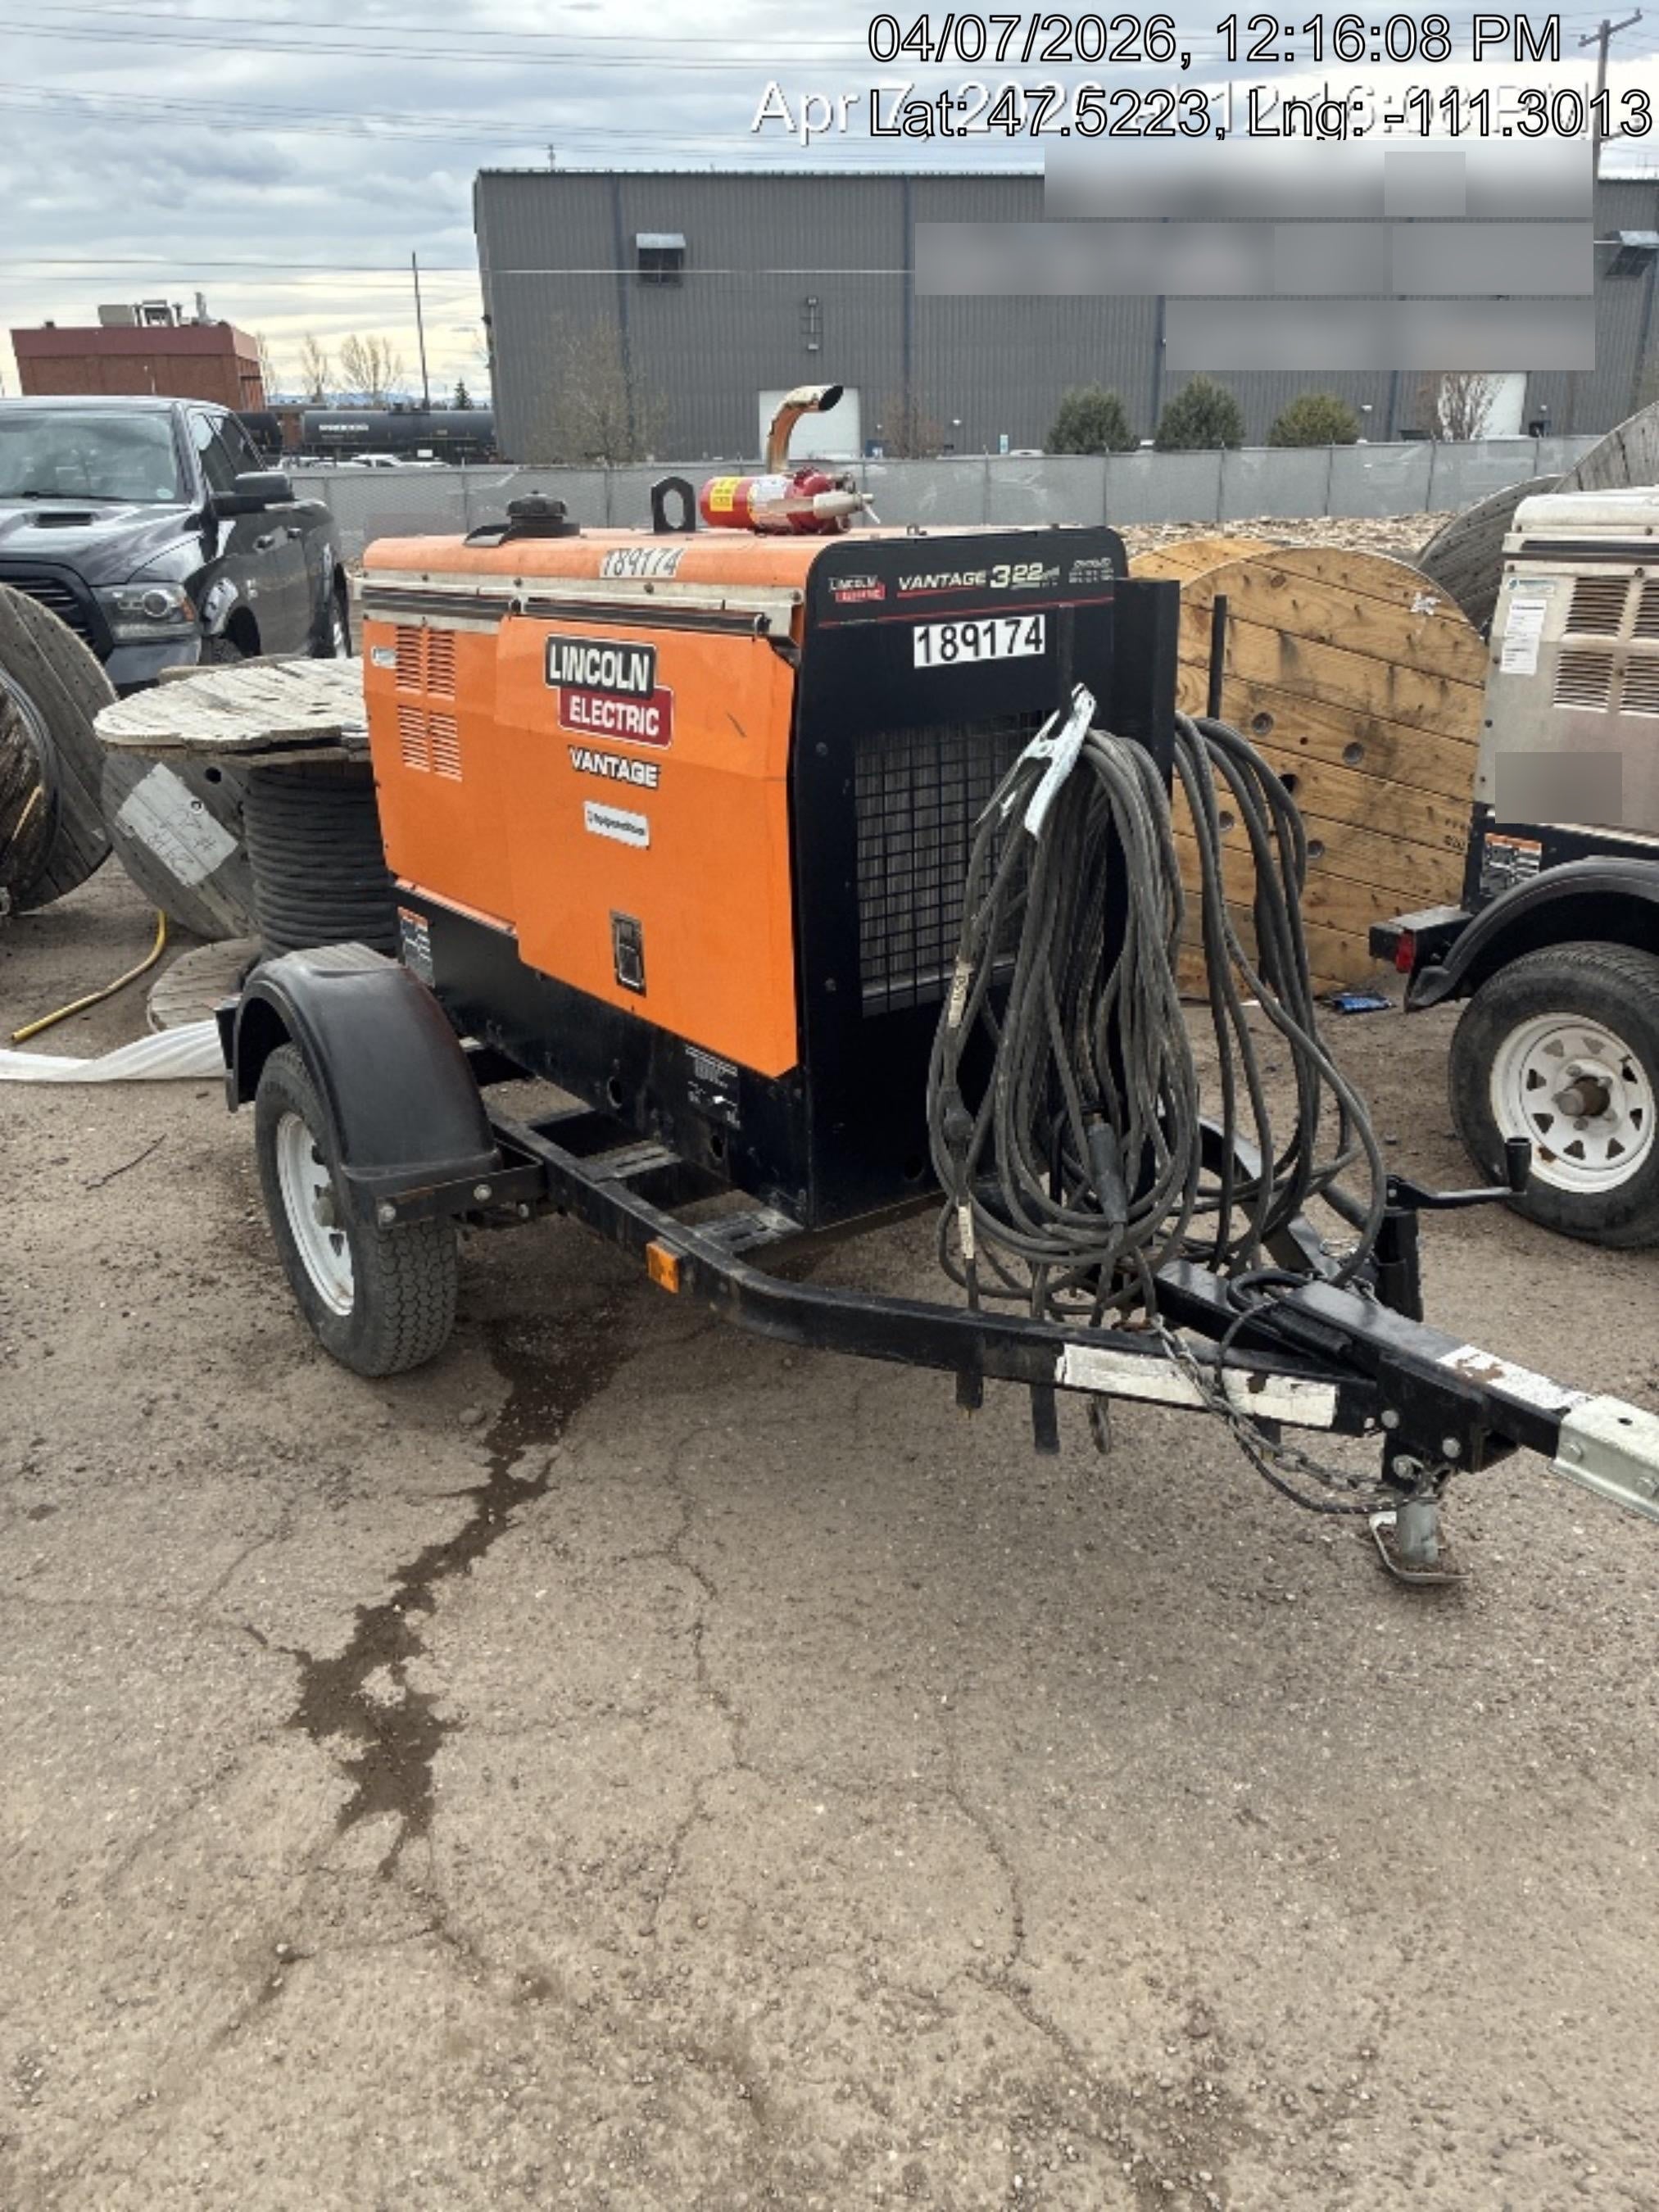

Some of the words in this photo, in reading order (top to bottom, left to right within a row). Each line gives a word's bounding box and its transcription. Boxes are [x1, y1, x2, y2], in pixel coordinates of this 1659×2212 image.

[898, 570, 987, 592] VANTAGE
[990, 561, 1044, 589] 322
[917, 615, 1043, 665] 189174
[549, 644, 650, 692] LINCOLN
[569, 694, 660, 737] ELECTRIC
[567, 745, 660, 790] VANTAGE
